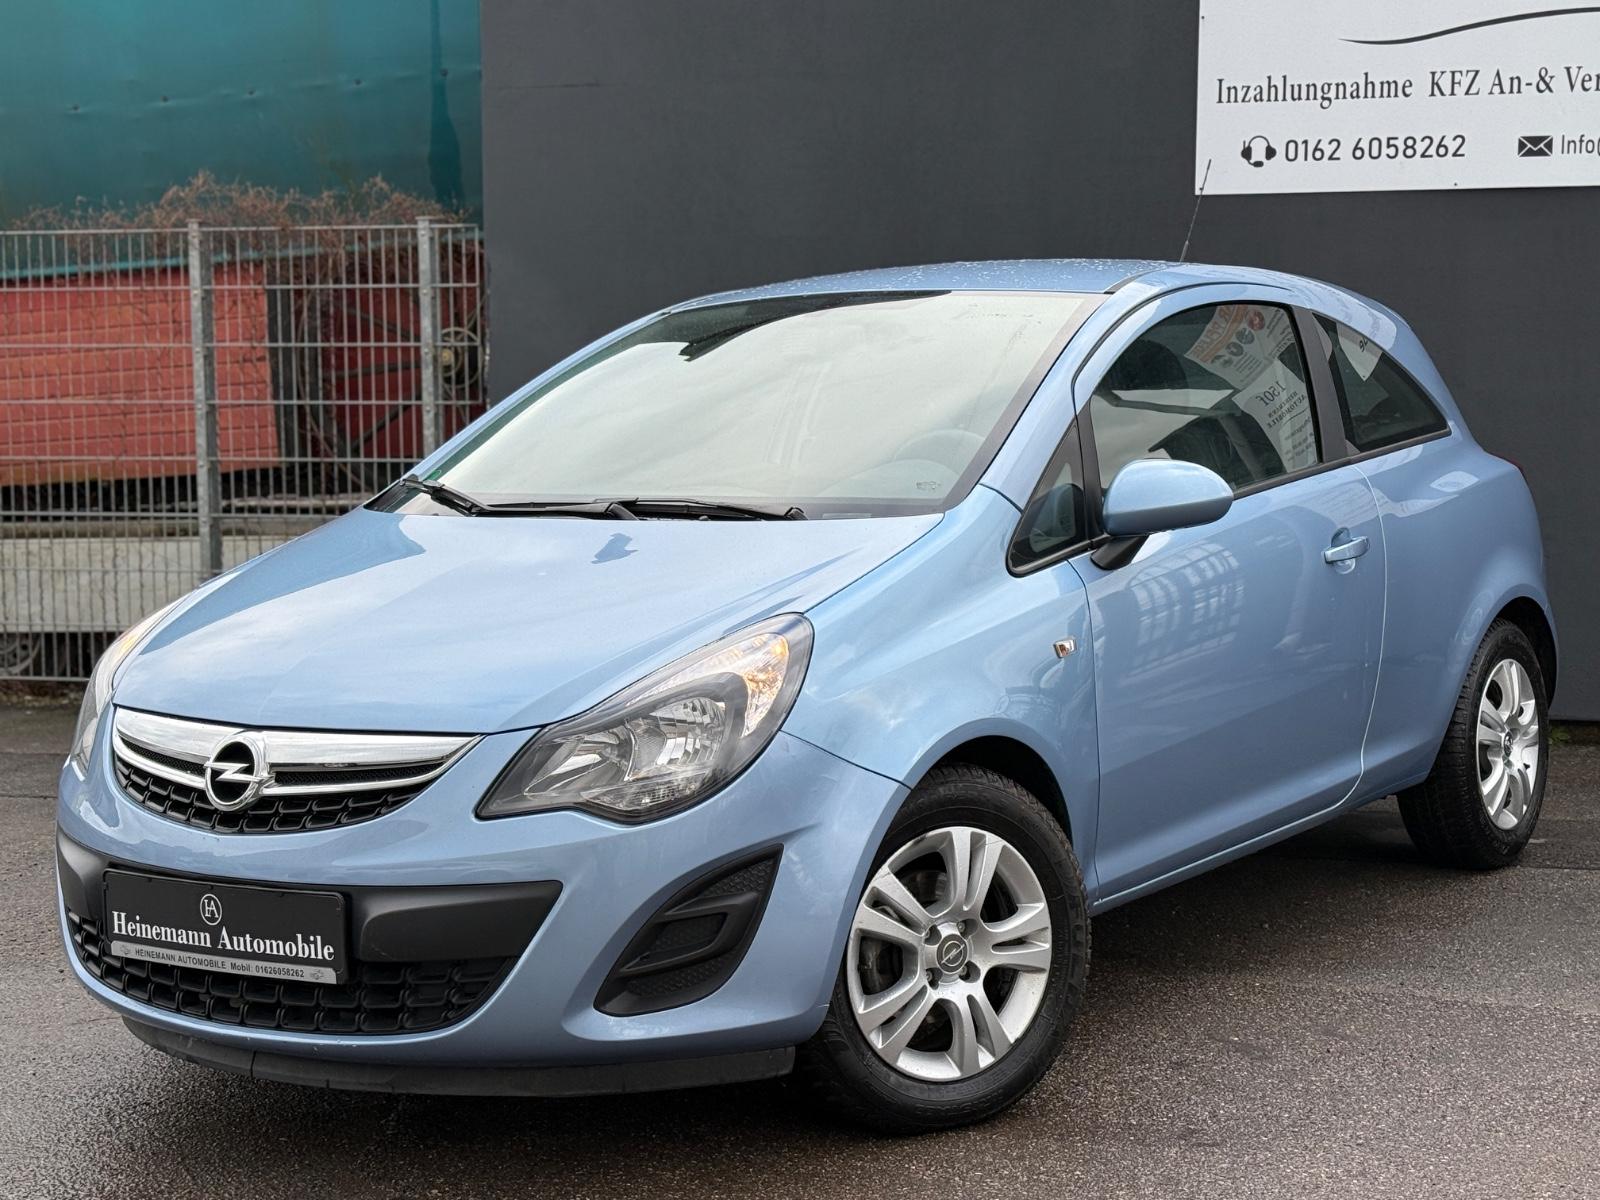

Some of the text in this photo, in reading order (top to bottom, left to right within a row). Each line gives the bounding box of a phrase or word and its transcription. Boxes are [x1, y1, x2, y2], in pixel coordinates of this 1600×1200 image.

[1216, 72, 1413, 109] Inzahlungnahme
[1428, 69, 1481, 98] KFZ
[1284, 134, 1466, 162] 0162 6058262
[1561, 134, 1600, 156] Info
[112, 911, 335, 961] Heinemann Automobile
[135, 948, 176, 962] HEINEMANN
[177, 955, 226, 970] AUTOMOBILE
[255, 964, 305, 978] 01626058262
